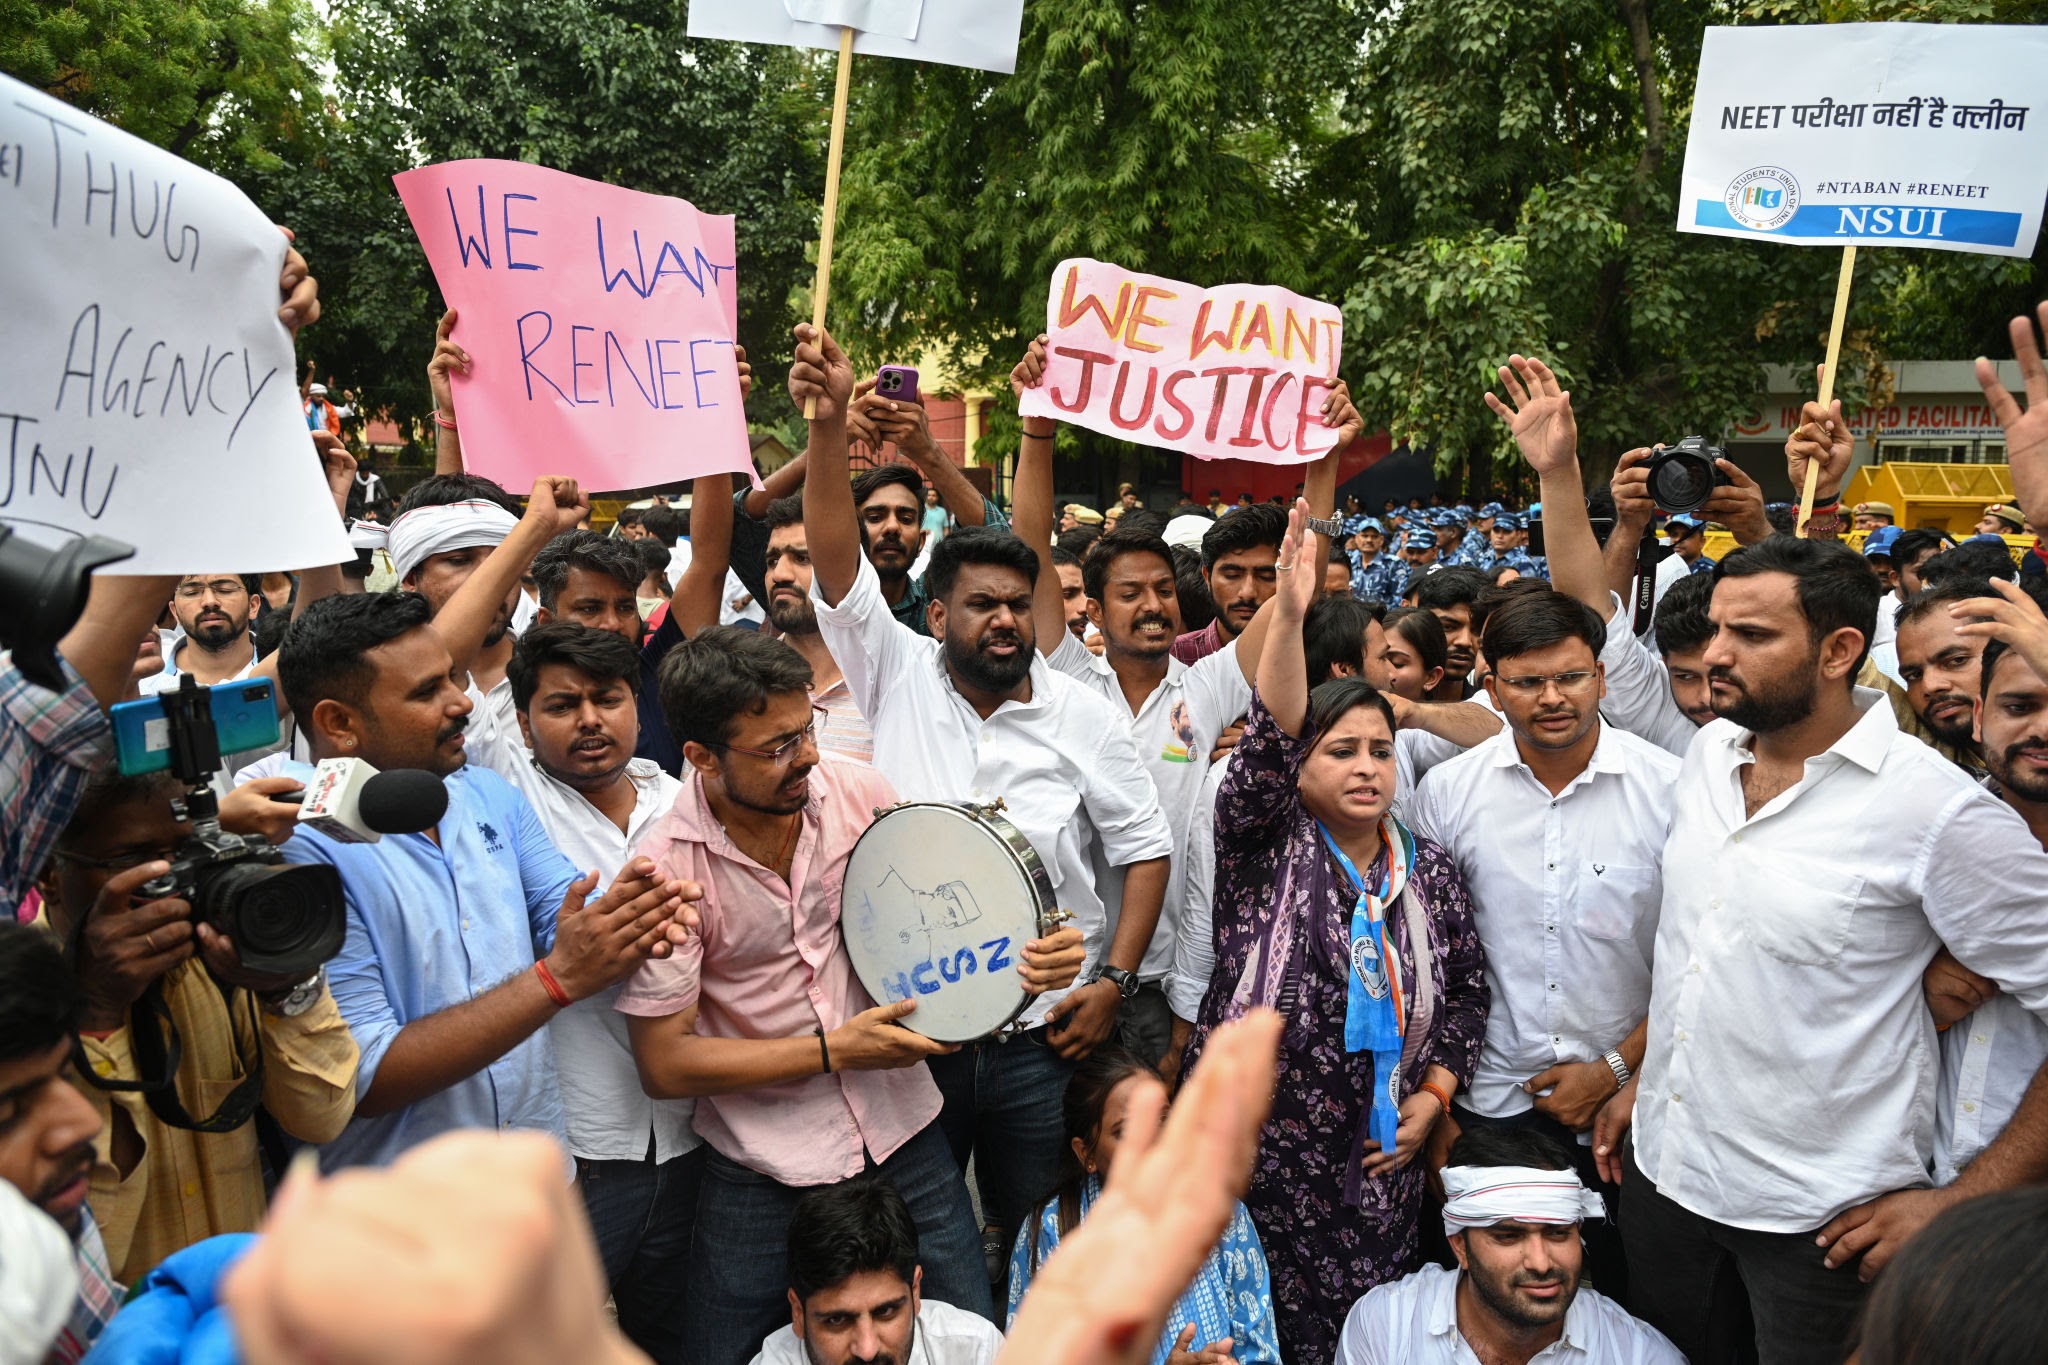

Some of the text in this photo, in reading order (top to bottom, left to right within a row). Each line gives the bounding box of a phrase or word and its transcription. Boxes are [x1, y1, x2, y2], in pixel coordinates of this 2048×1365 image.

[1721, 96, 2030, 131] NEET परीक्षा नहीं है क्लीन
[13, 101, 199, 272] THUG
[1779, 173, 1797, 196] UNION
[1816, 181, 1989, 198] #NTABAN #RENEET
[1728, 192, 1749, 224] NATIONAL
[1769, 210, 1791, 227] INDIA
[1788, 198, 1796, 210] OF
[446, 185, 544, 270] WE
[1835, 207, 1947, 237] NSUI
[1058, 265, 1341, 379] WE WANT
[55, 303, 278, 451] AGENCY
[1049, 346, 1338, 456] JUSTICE
[0, 413, 118, 520] JNU
[1640, 576, 1651, 610] Canon
